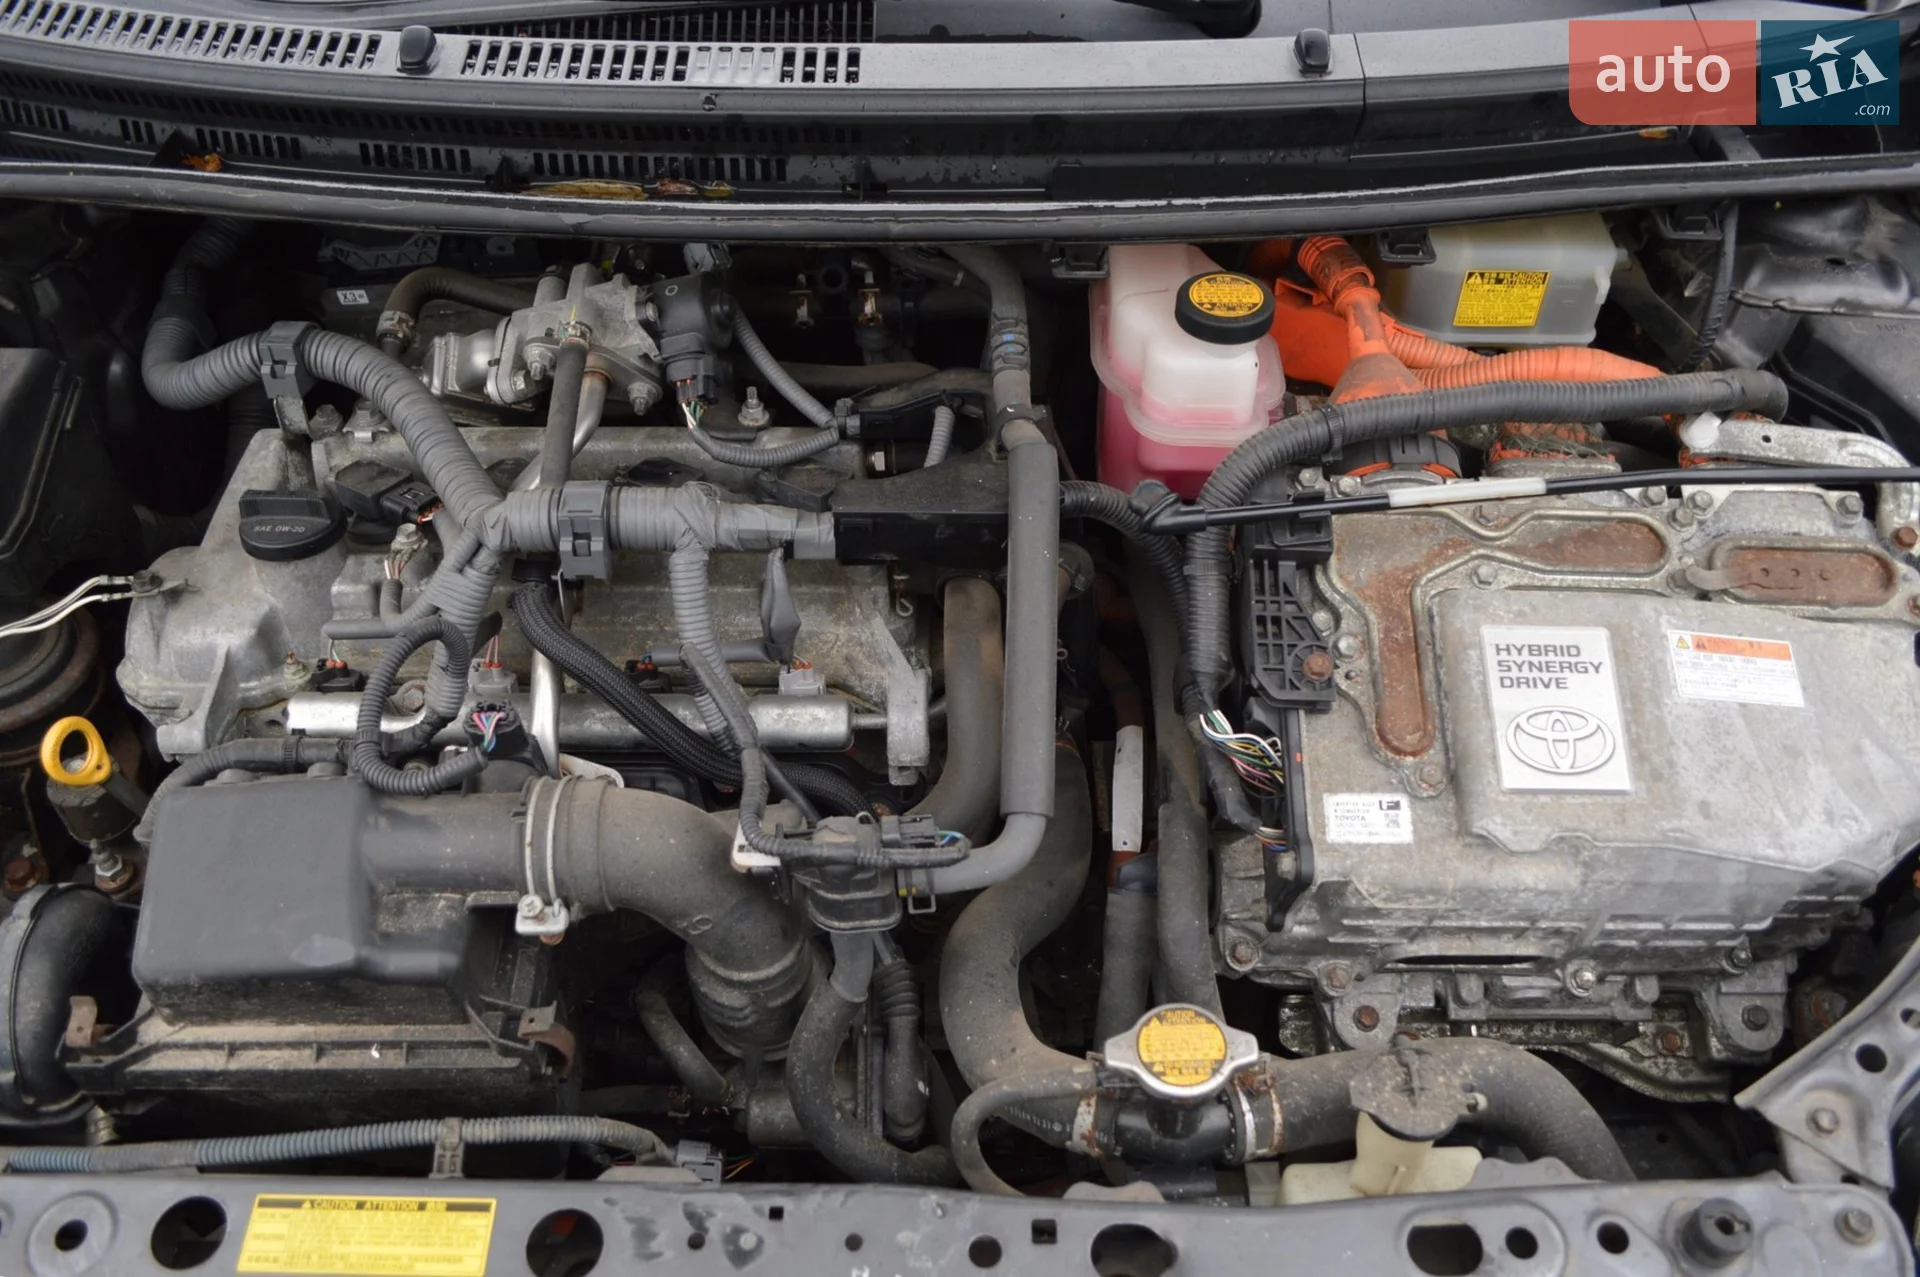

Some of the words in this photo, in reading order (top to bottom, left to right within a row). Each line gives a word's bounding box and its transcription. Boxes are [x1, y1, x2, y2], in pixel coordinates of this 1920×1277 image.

[275, 525, 306, 533] 0W-20
[1495, 643, 1581, 658] HYBRID
[1497, 659, 1603, 674] SYNERGY
[1500, 676, 1569, 690] DRIVE
[313, 1200, 357, 1210] CAUTION
[364, 1201, 419, 1211] ATTENTION
